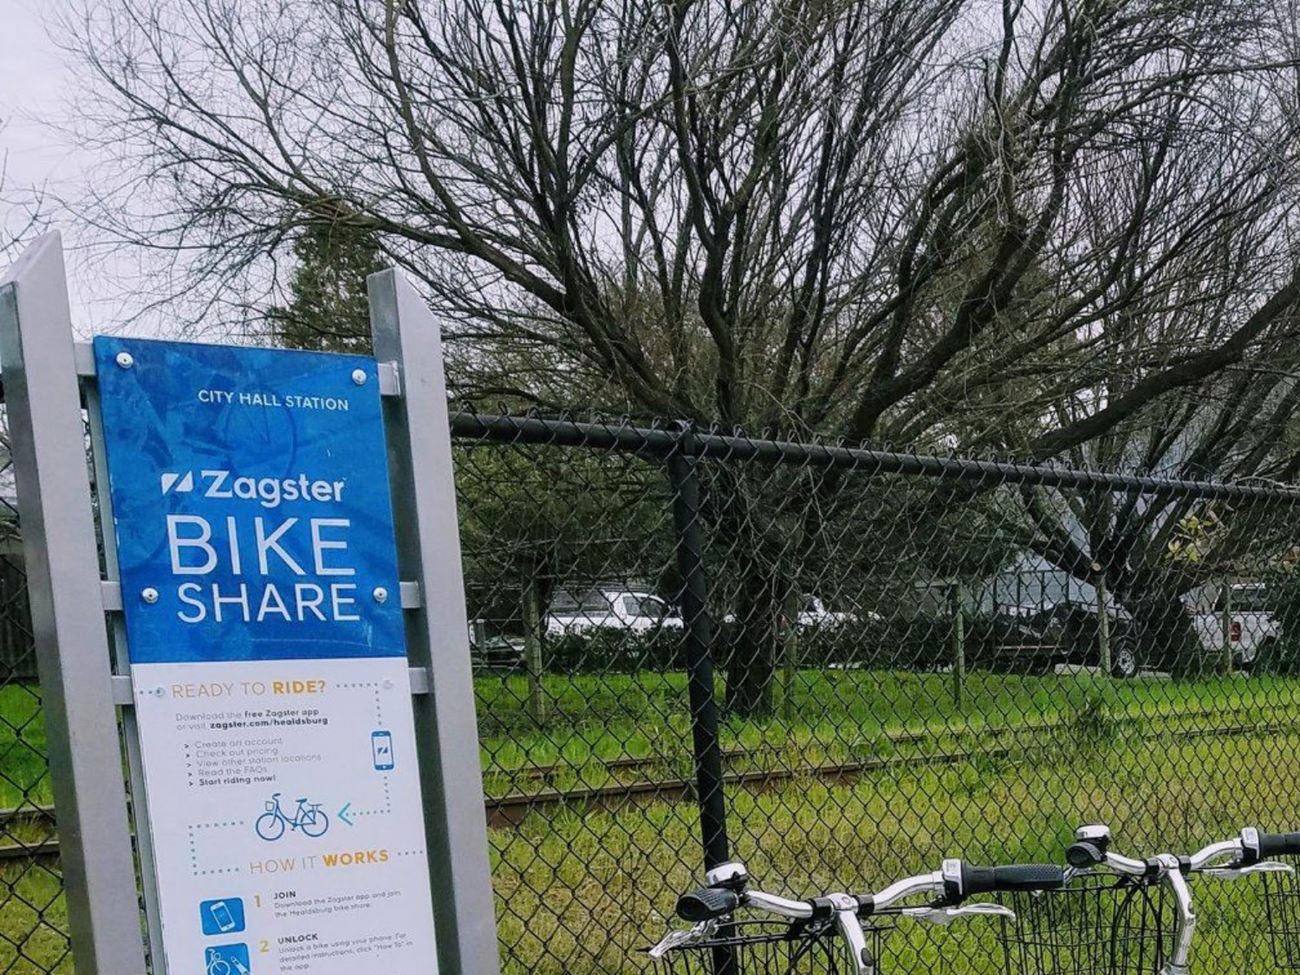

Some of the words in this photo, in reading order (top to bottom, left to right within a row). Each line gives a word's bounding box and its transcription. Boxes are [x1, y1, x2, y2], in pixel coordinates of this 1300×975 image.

[198, 389, 233, 404] CITY
[239, 392, 282, 407] HALL
[285, 395, 349, 411] STATION
[200, 469, 346, 508] Zagster
[166, 514, 355, 576] BIKE
[177, 582, 360, 623] SHARE
[172, 682, 234, 698] READY
[240, 682, 266, 696] TO
[272, 680, 326, 695] RIDE?
[175, 711, 225, 722] Download
[226, 712, 242, 720] the
[244, 710, 263, 719] free
[265, 709, 299, 719] Zagster
[301, 709, 320, 718] app
[209, 717, 329, 731] zagster.com/healdsburg
[194, 739, 227, 749] Create
[244, 737, 283, 747] account
[196, 748, 227, 758] Check
[229, 748, 244, 756] out
[246, 746, 279, 757] pricing
[196, 758, 220, 767] View
[221, 757, 246, 766] other
[247, 756, 279, 765] station
[280, 753, 322, 763] locations
[197, 767, 224, 777] Read
[226, 767, 242, 775] the
[243, 764, 268, 774] FAQs
[198, 777, 222, 787] Start
[223, 775, 251, 786] riding
[252, 774, 277, 783] now!
[250, 858, 296, 875] HOW
[301, 855, 318, 870] IT
[322, 849, 390, 868] WORKS
[253, 895, 261, 908] 1
[273, 890, 296, 900] JOIN
[274, 898, 313, 909] Download
[327, 894, 354, 905] Zagster
[355, 893, 370, 902] app
[371, 891, 386, 899] and
[289, 906, 332, 918] Healdsburg
[333, 904, 349, 912] bike
[277, 932, 319, 945] UNLOCK
[259, 940, 270, 953] 2
